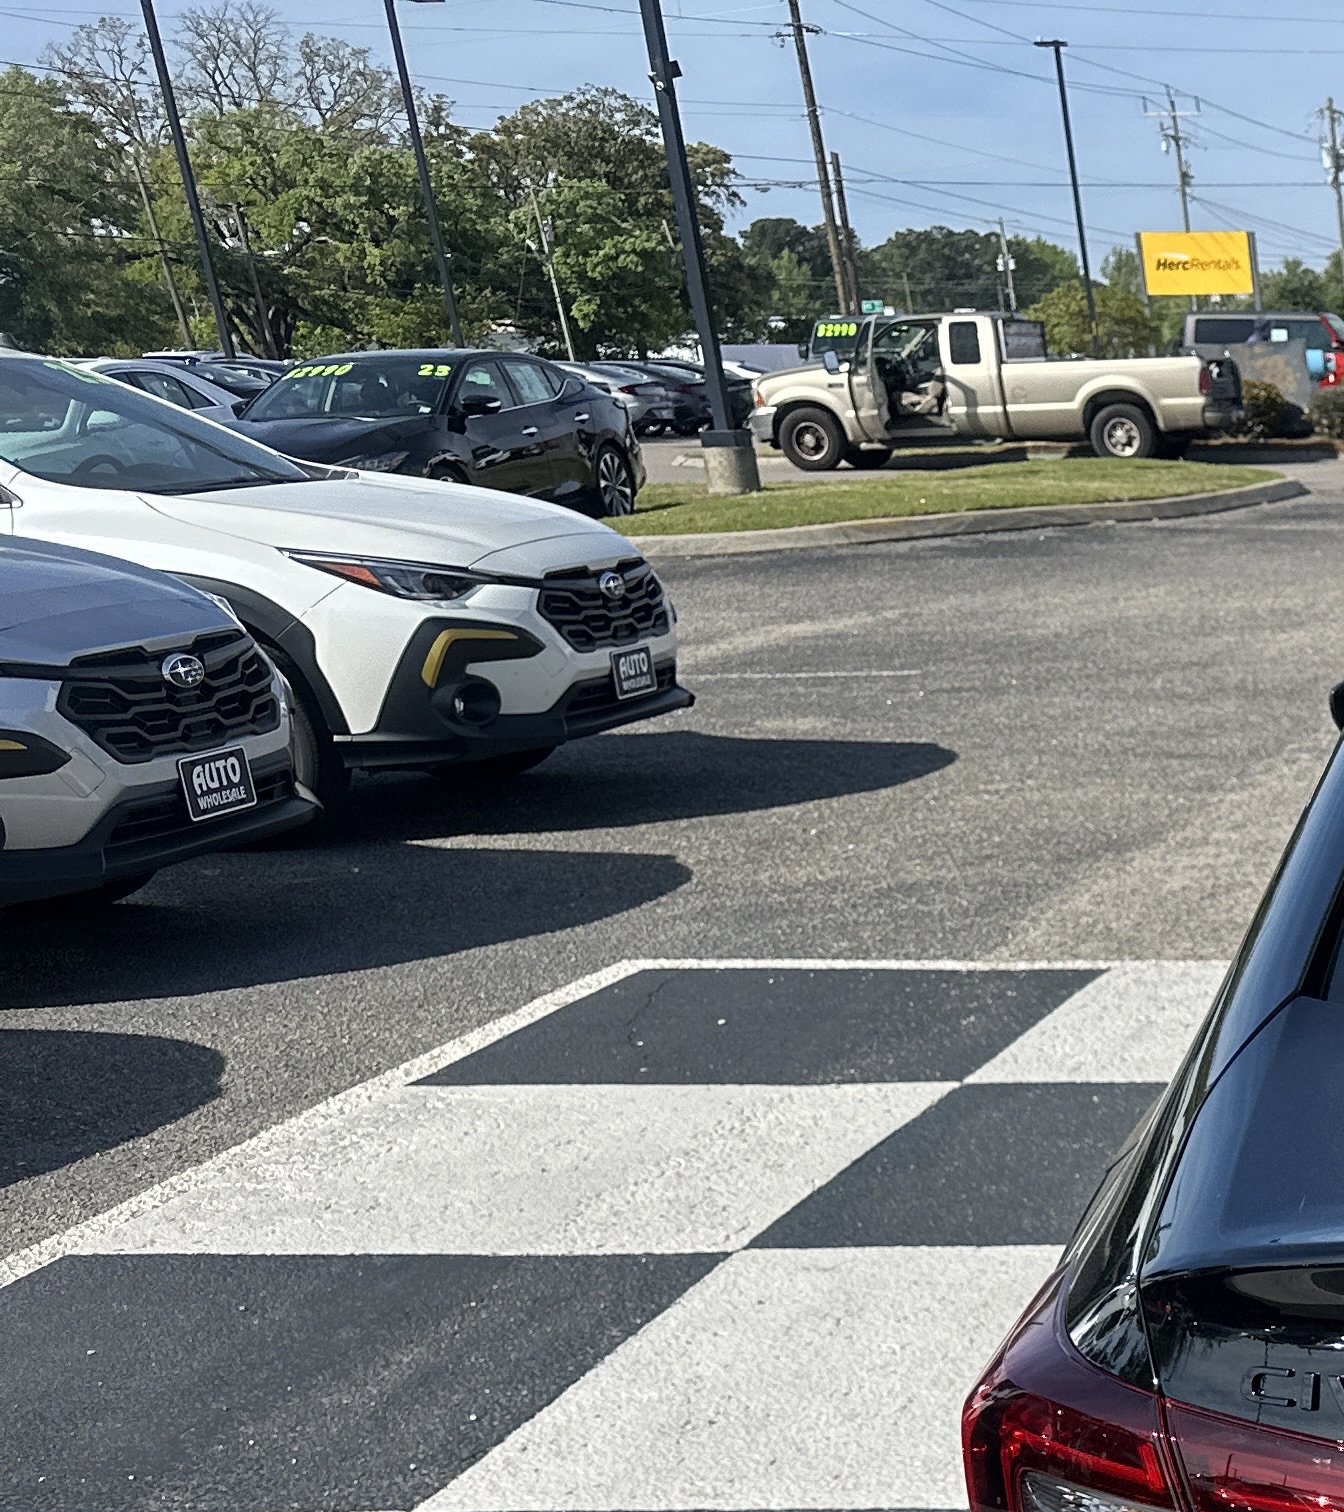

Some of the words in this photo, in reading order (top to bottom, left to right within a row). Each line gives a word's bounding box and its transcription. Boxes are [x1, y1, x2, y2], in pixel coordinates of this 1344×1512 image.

[619, 652, 648, 680] AUTO
[192, 756, 241, 796] AUTO
[197, 786, 247, 810] WHOLESALE
